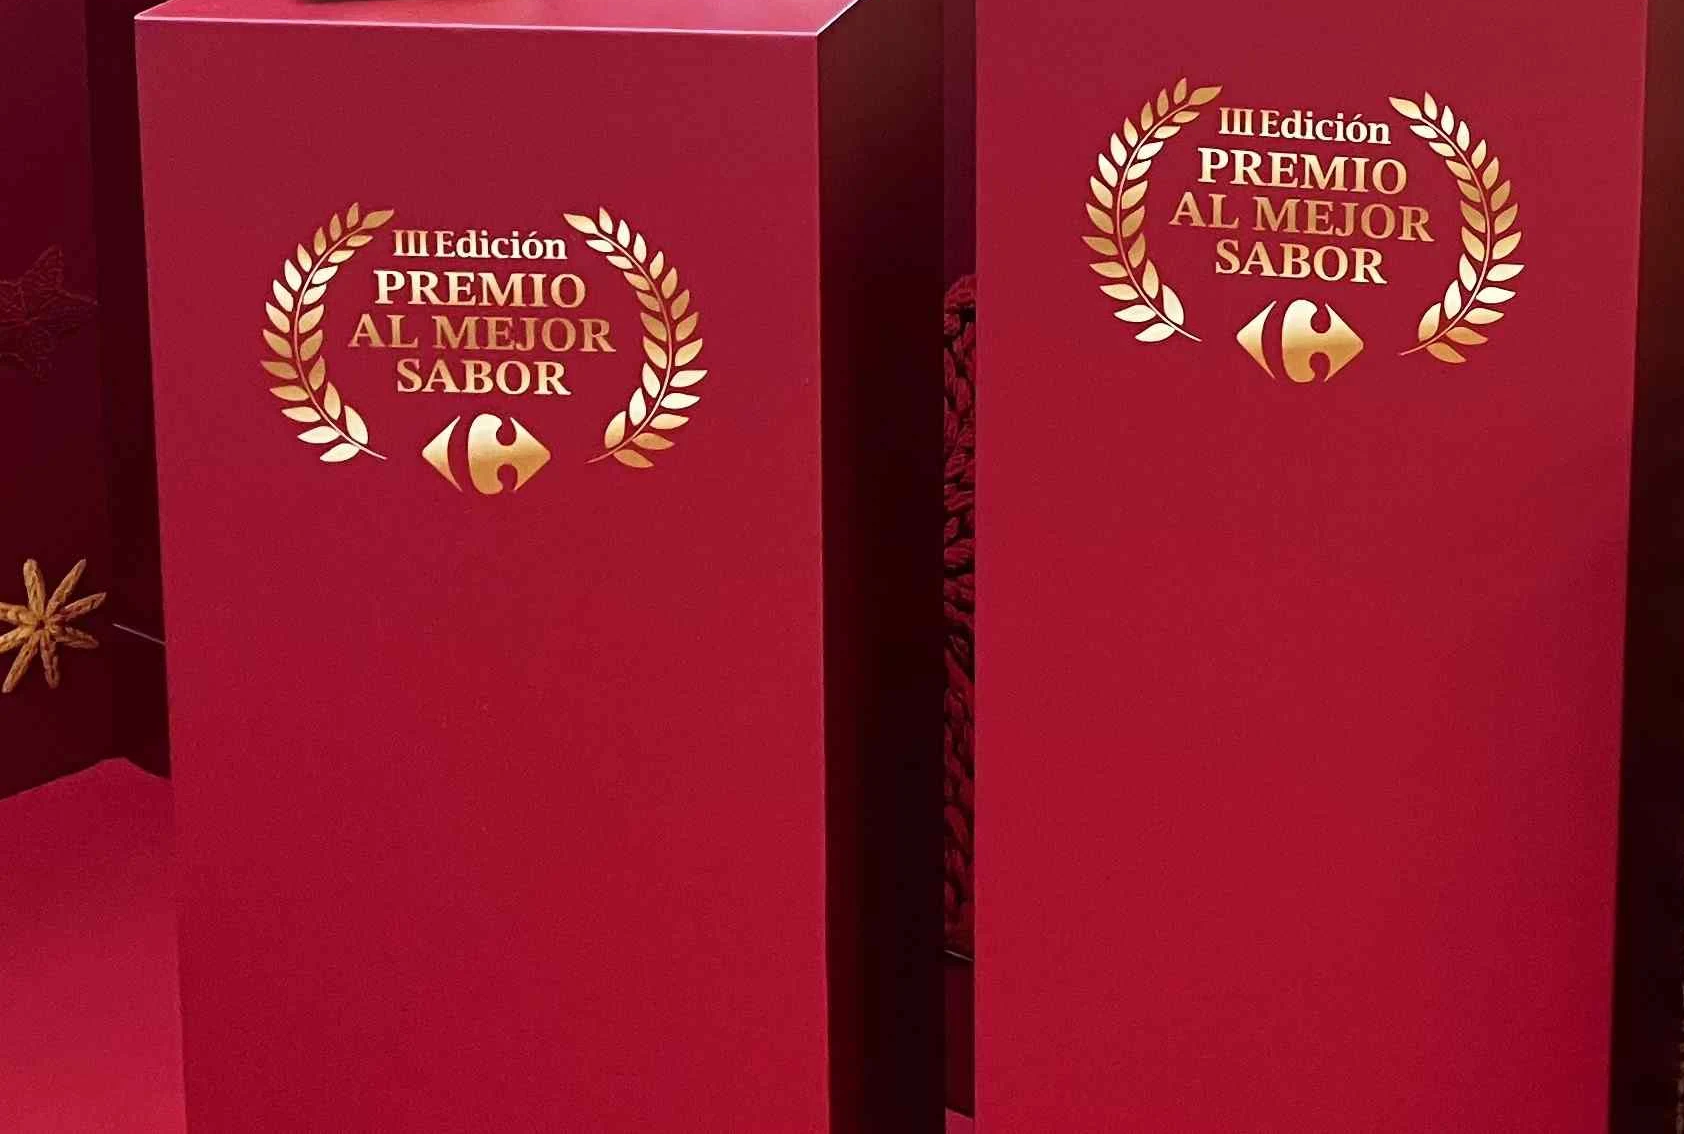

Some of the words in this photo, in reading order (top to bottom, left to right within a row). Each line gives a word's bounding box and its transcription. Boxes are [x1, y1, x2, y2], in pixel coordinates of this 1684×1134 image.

[1218, 106, 1255, 137] III
[1260, 109, 1392, 146] Edición
[1197, 146, 1408, 195] PREMIO
[1168, 191, 1240, 230] AL
[1252, 195, 1436, 244] MEJOR
[393, 229, 428, 257] III
[436, 228, 569, 260] Edición
[1214, 238, 1388, 286] SABOR
[373, 269, 587, 309] PREMIO
[347, 313, 420, 349] AL
[432, 314, 617, 353] MEJOR
[396, 358, 572, 396] SABOR
